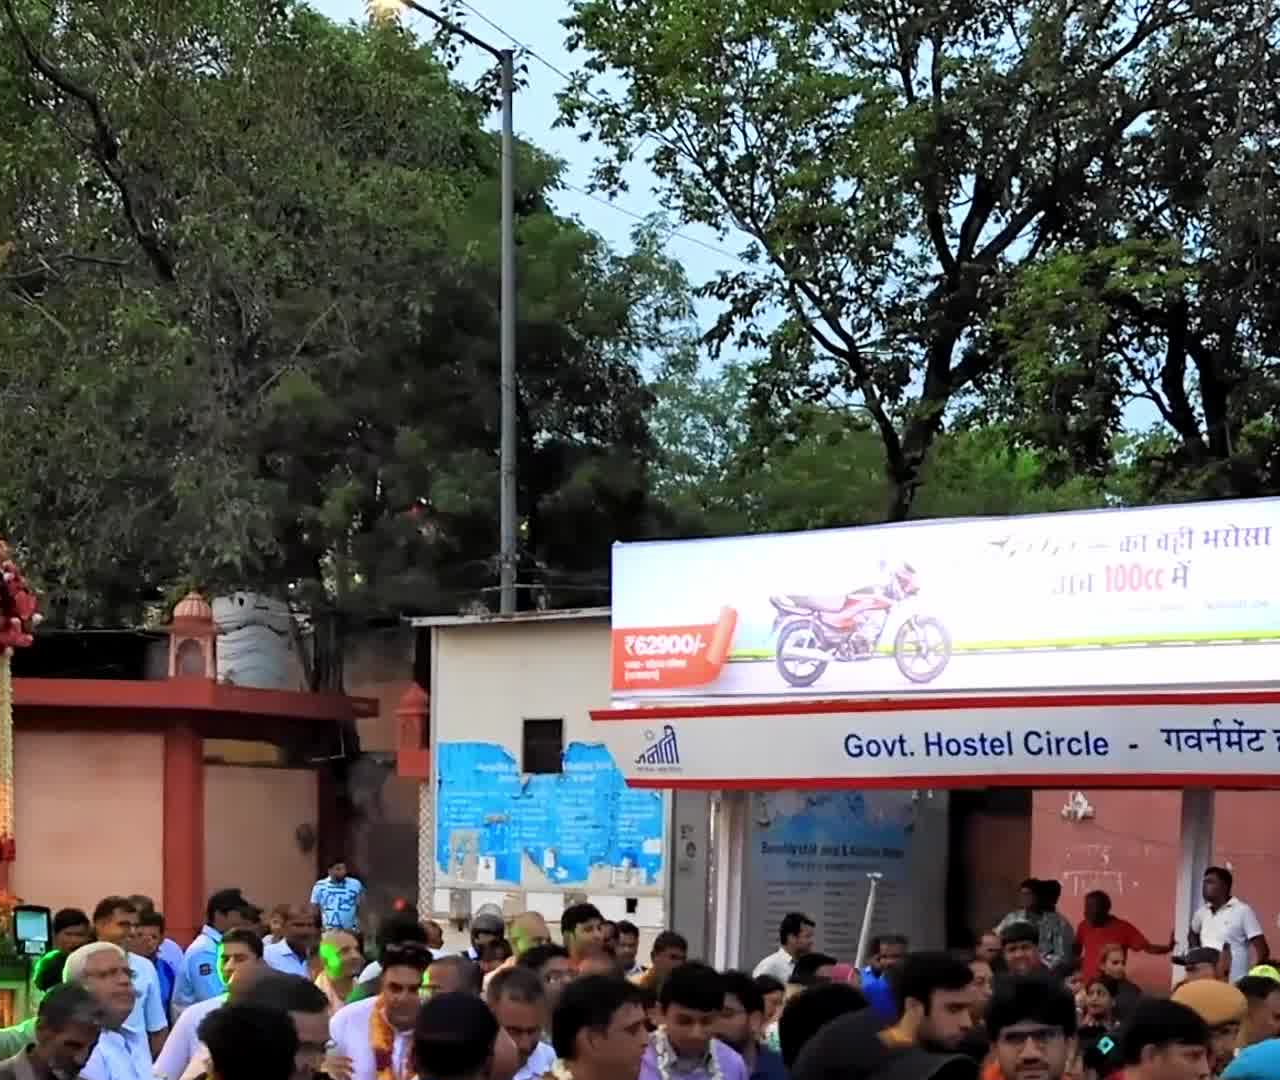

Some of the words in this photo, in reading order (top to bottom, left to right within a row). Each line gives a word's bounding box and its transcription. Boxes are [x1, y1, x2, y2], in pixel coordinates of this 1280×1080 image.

[1203, 523, 1273, 549] भरोसा
[1104, 563, 1166, 592] 100cc
[1171, 560, 1192, 588] में
[844, 732, 915, 758] Govt.
[924, 730, 1014, 757] Hostel
[1023, 730, 1110, 756] Circle
[1160, 718, 1267, 753] गवर्नमेंट
